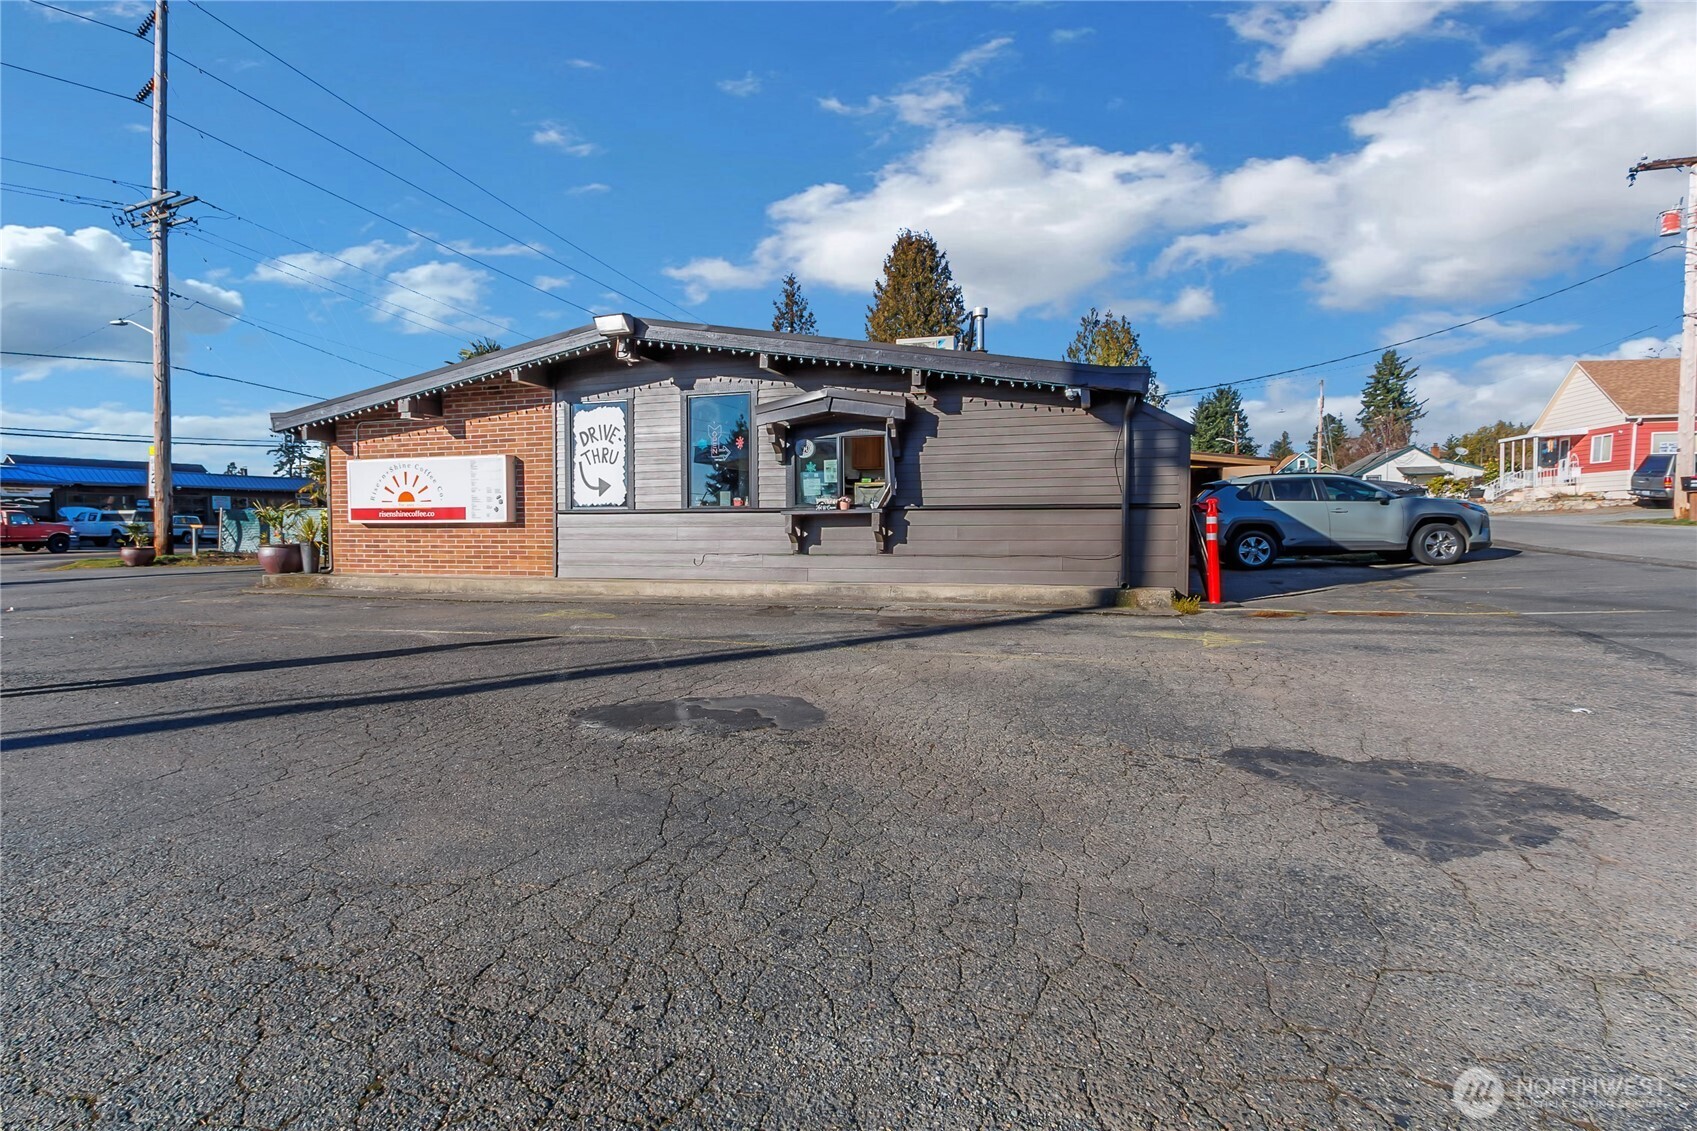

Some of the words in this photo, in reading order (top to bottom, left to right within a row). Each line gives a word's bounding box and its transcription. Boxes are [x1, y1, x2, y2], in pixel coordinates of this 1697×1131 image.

[580, 447, 619, 465] THRU
[414, 463, 437, 483] Coffee
[379, 510, 435, 518] risenshinecoffee.co
